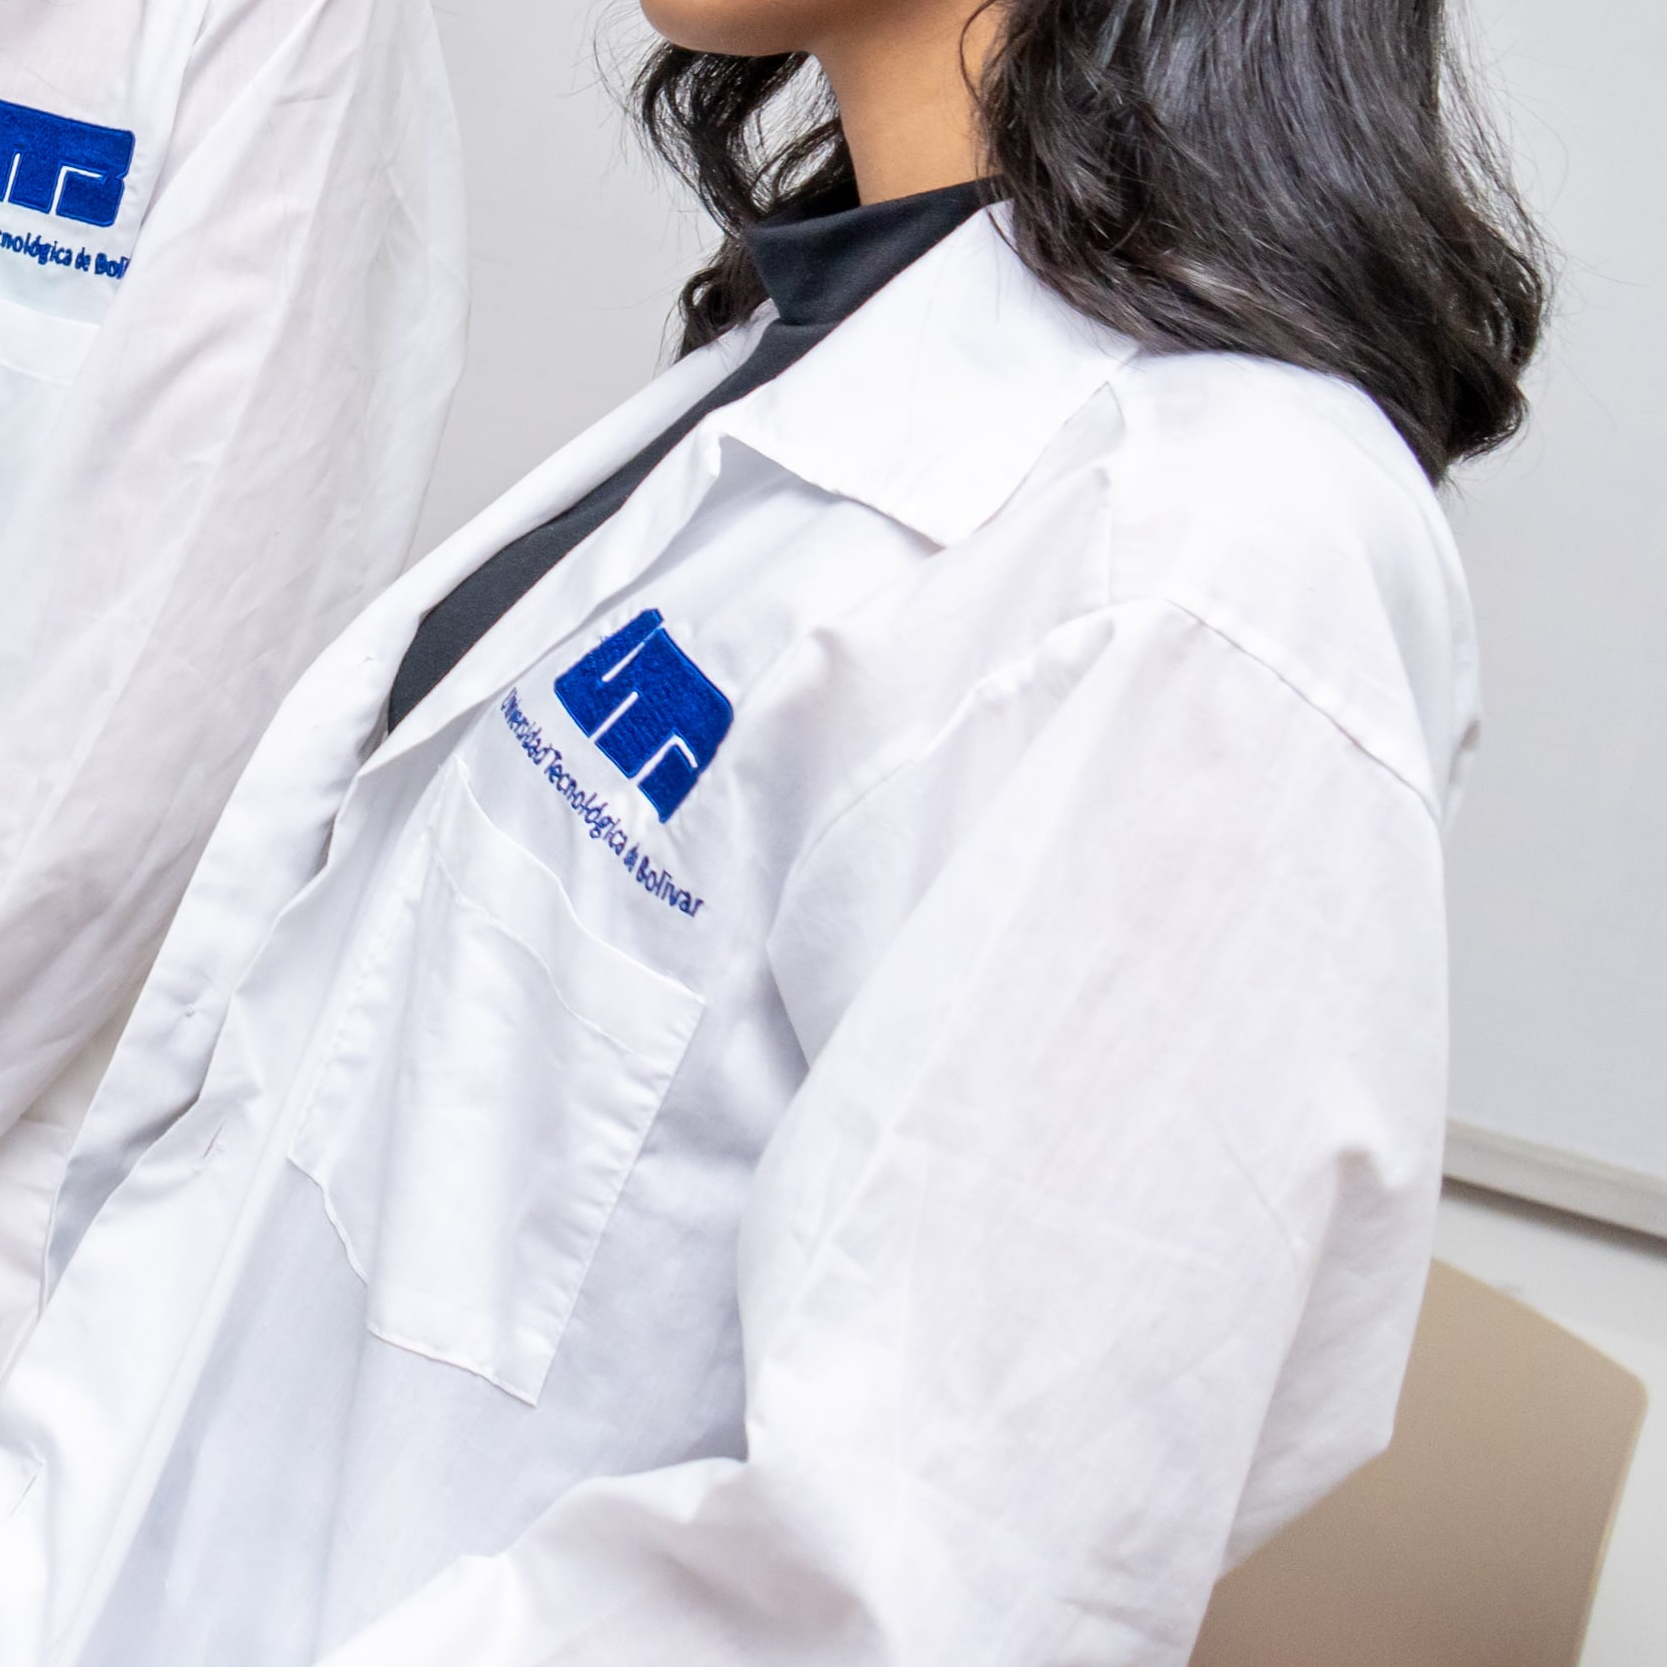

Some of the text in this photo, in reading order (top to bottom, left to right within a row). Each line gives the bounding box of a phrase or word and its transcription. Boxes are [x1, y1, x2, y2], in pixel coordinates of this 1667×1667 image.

[74, 246, 92, 273] de
[543, 743, 629, 857] Tecnológica
[636, 855, 705, 918] Bolívar
